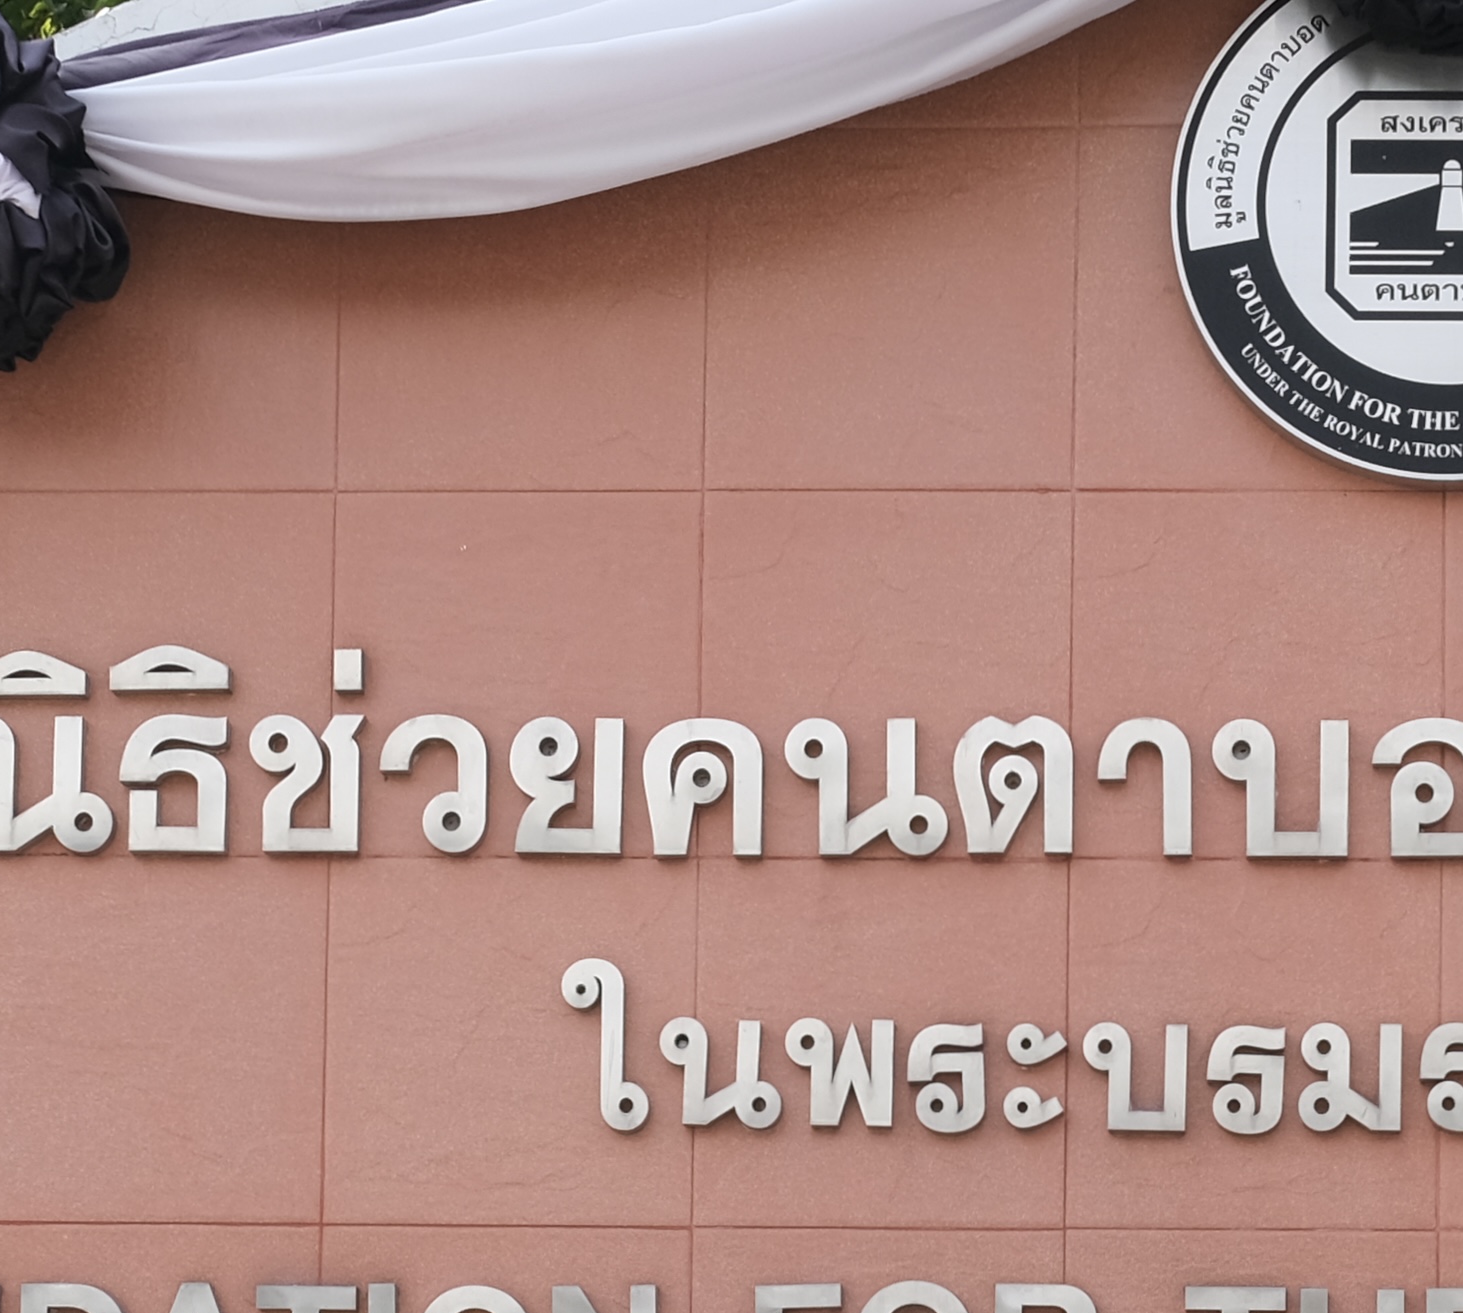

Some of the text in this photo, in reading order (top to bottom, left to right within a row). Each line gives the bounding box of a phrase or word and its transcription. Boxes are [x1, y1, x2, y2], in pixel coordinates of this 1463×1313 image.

[1230, 264, 1349, 403] FOUNDATION
[1347, 390, 1403, 426] FOR
[1407, 408, 1461, 431] THE
[1240, 343, 1290, 398] UNDER
[1288, 390, 1325, 422] THE
[1322, 413, 1385, 450] ROYAL
